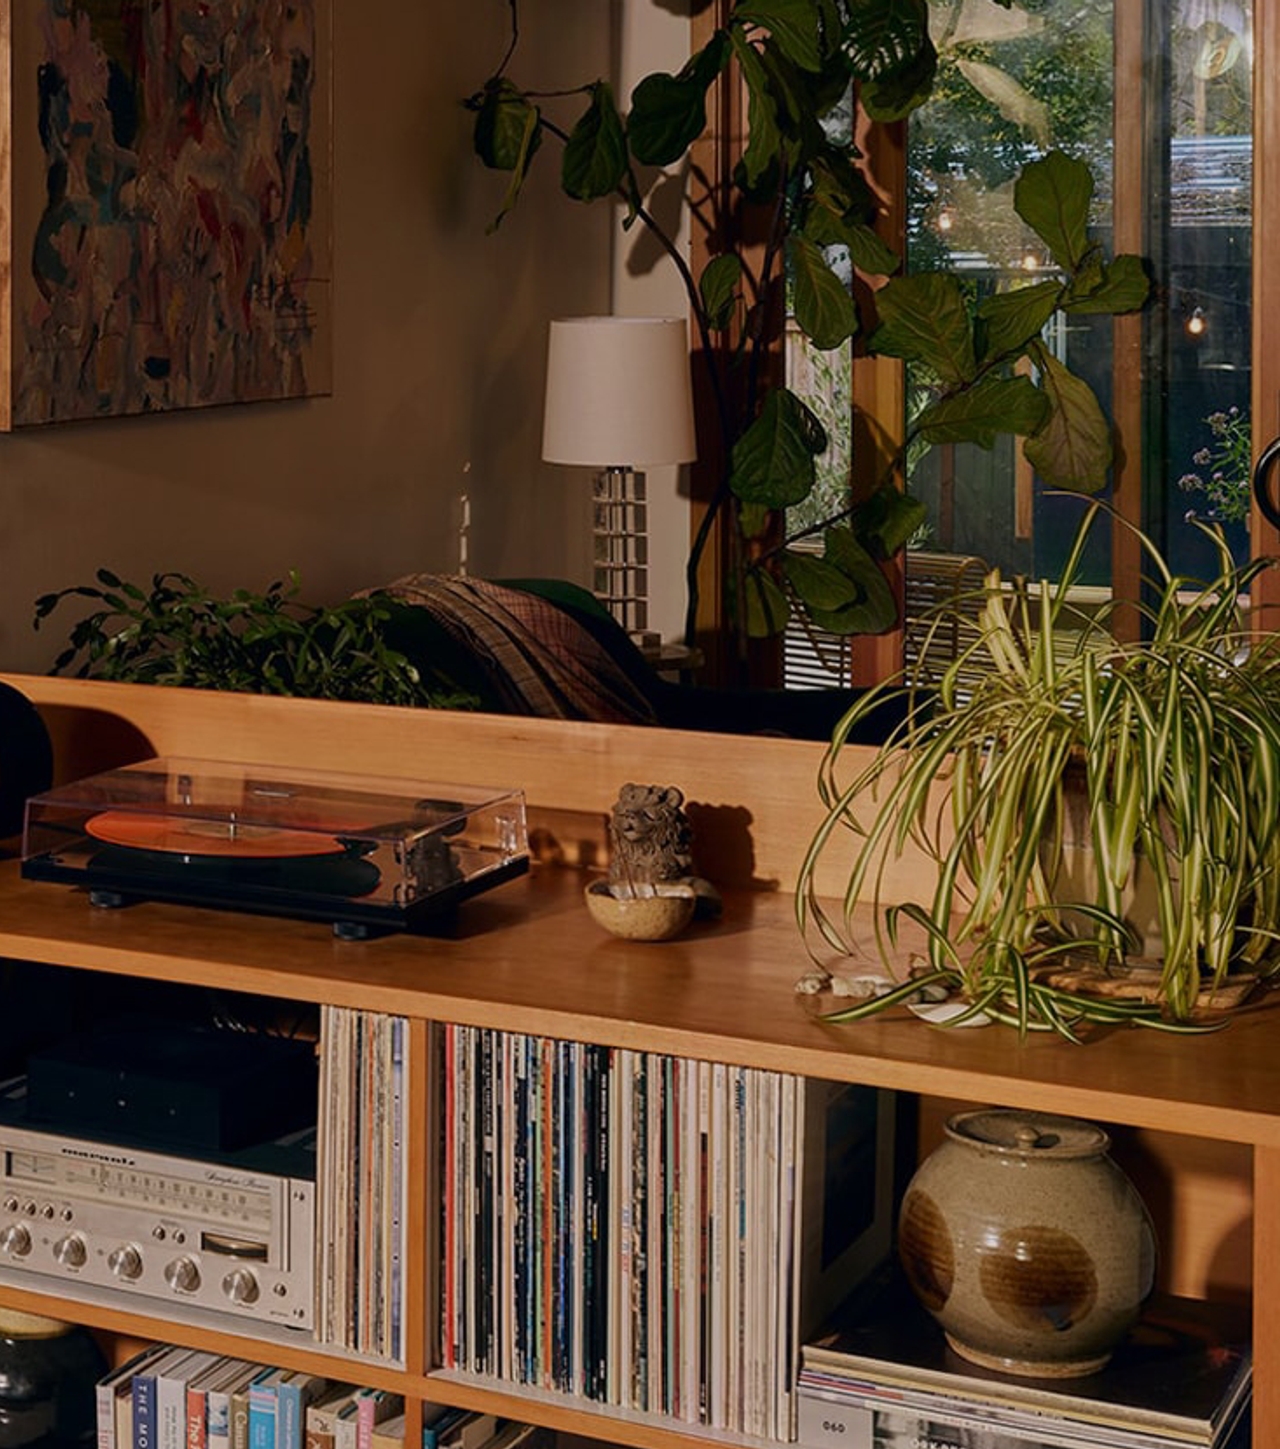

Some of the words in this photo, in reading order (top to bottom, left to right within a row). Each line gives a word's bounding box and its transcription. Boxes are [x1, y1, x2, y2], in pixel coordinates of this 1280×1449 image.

[61, 1148, 135, 1166] marantz
[138, 1384, 148, 1415] THE
[190, 1416, 202, 1443] The
[822, 1420, 846, 1433] 060
